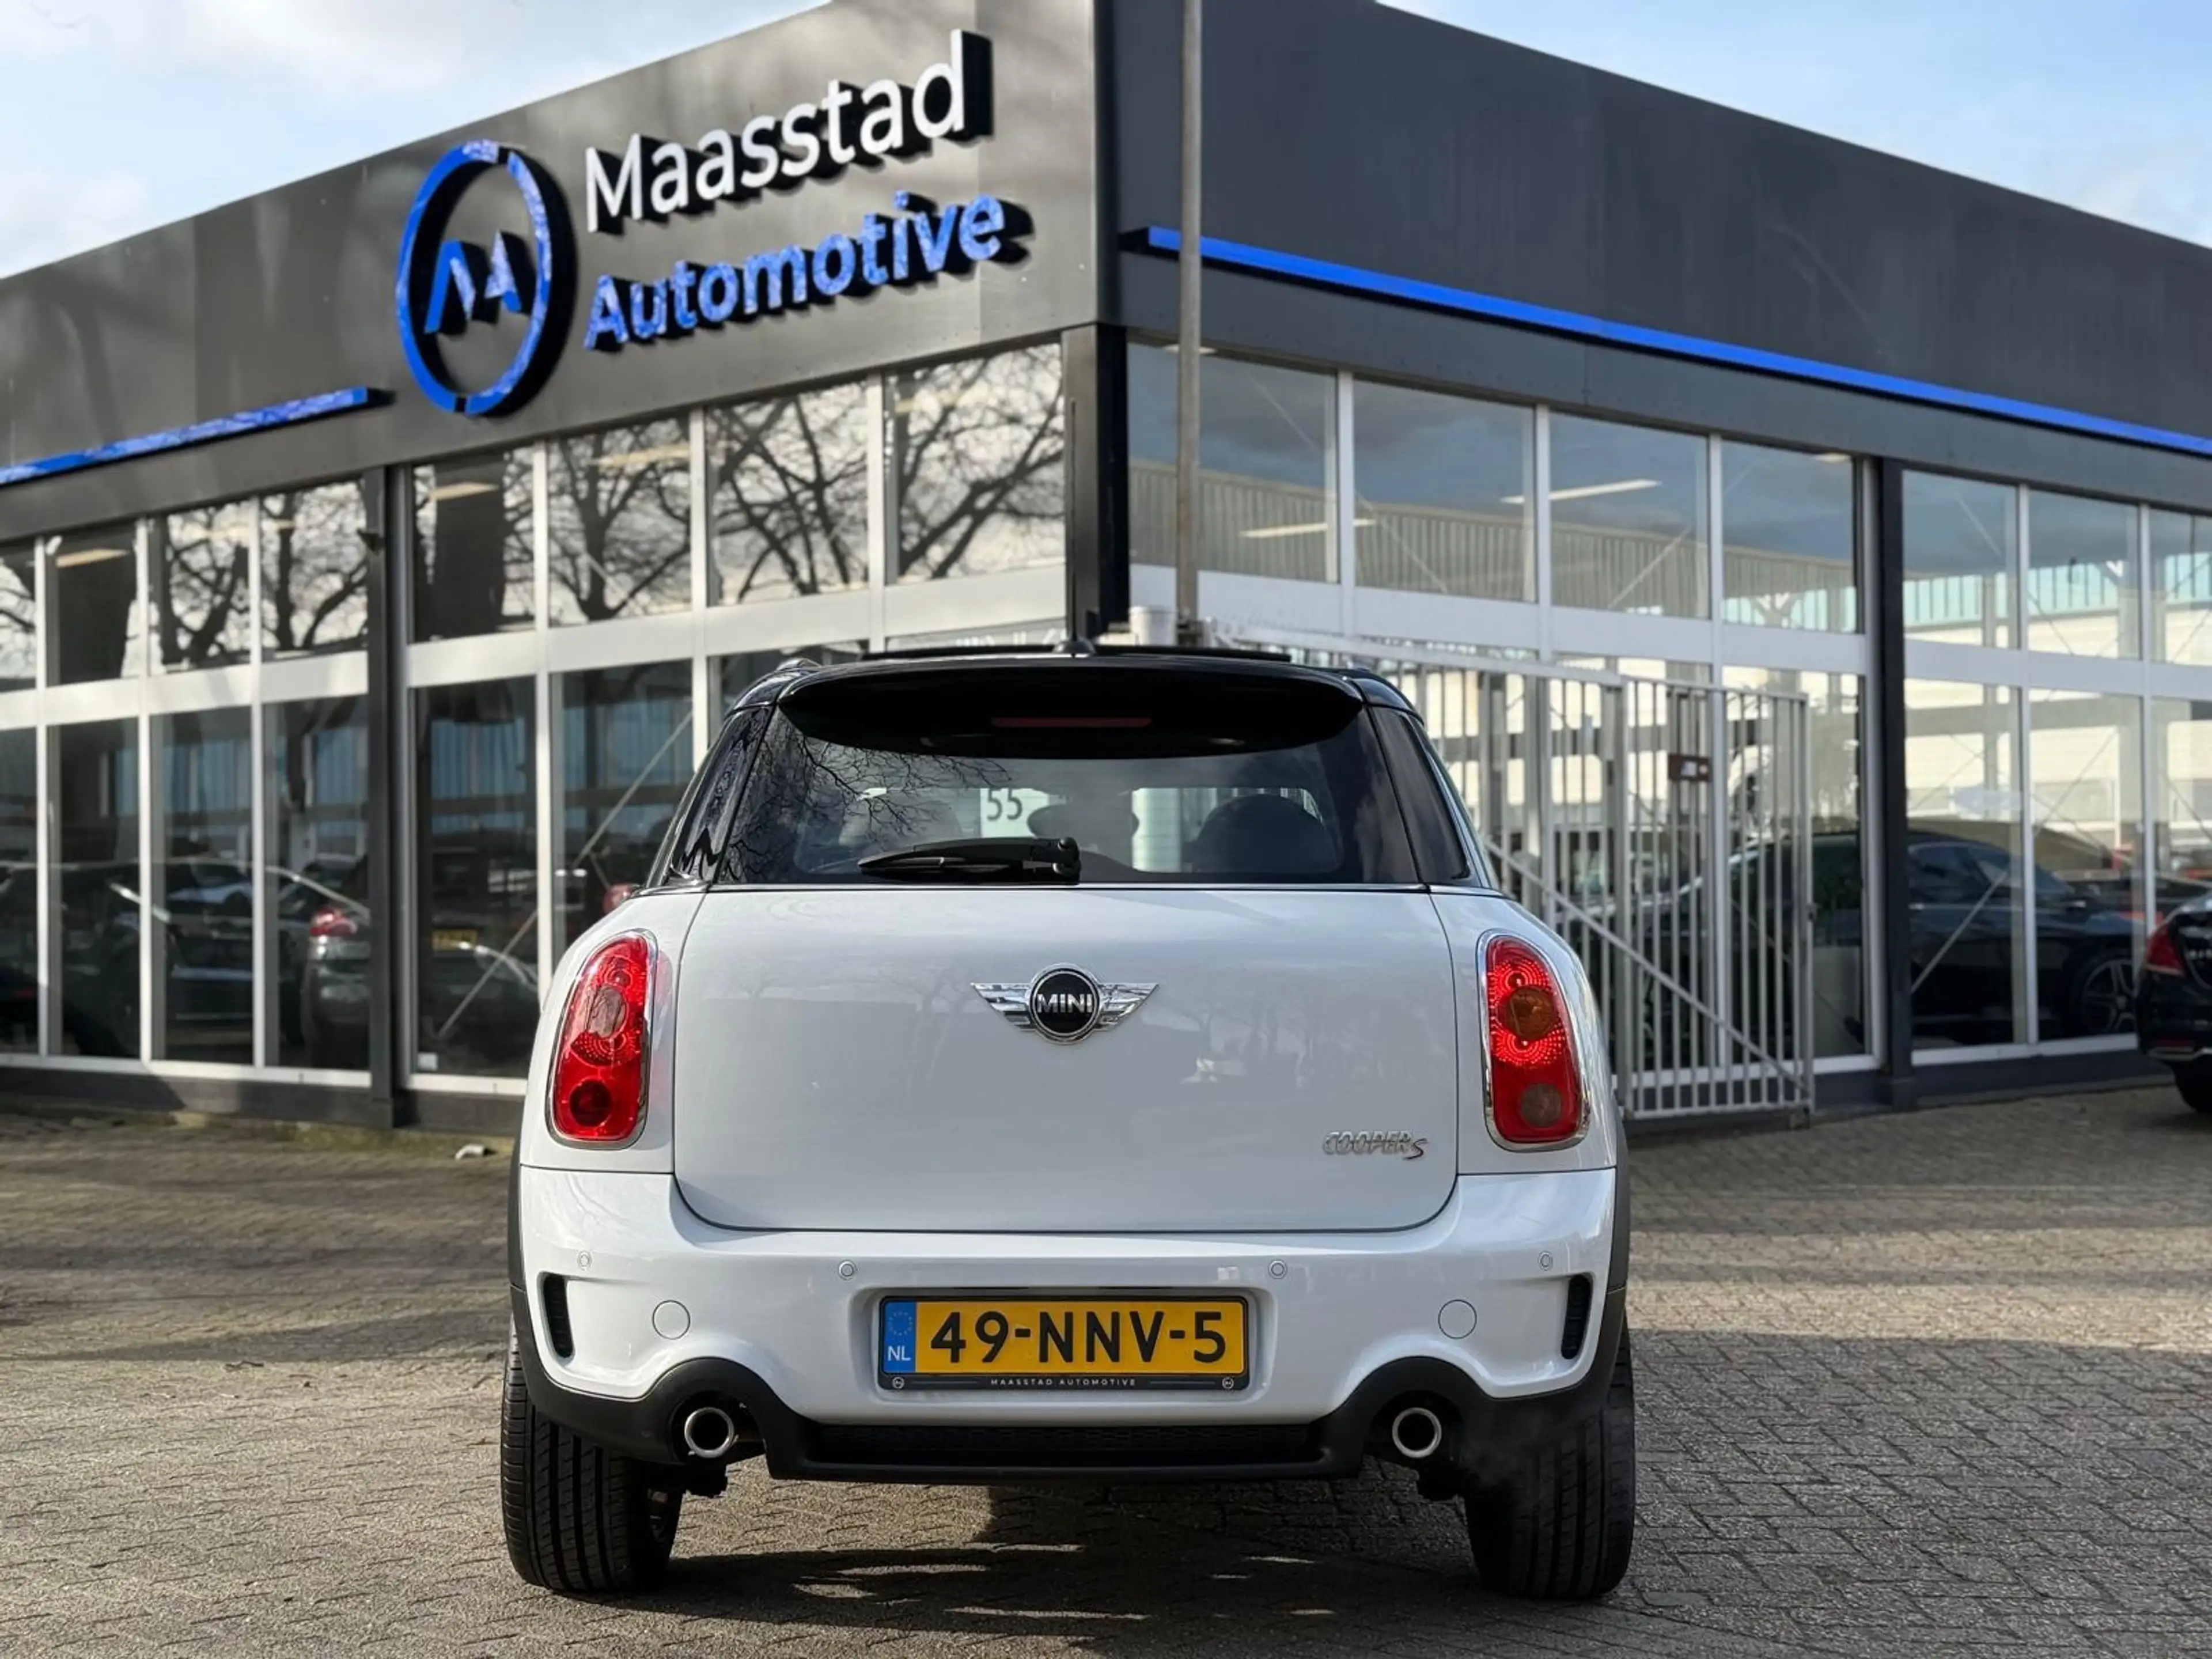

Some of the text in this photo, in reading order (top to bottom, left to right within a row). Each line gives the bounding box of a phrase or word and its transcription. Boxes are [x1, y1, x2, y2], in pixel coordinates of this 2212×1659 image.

[585, 29, 966, 233] Maasstad
[584, 190, 1006, 350] Automotive
[987, 787, 1022, 821] 55
[1036, 993, 1093, 1014] MINI
[1322, 1130, 1411, 1155] COOPER
[887, 1346, 911, 1361] NL
[930, 1310, 1226, 1363] 49-NNV-5
